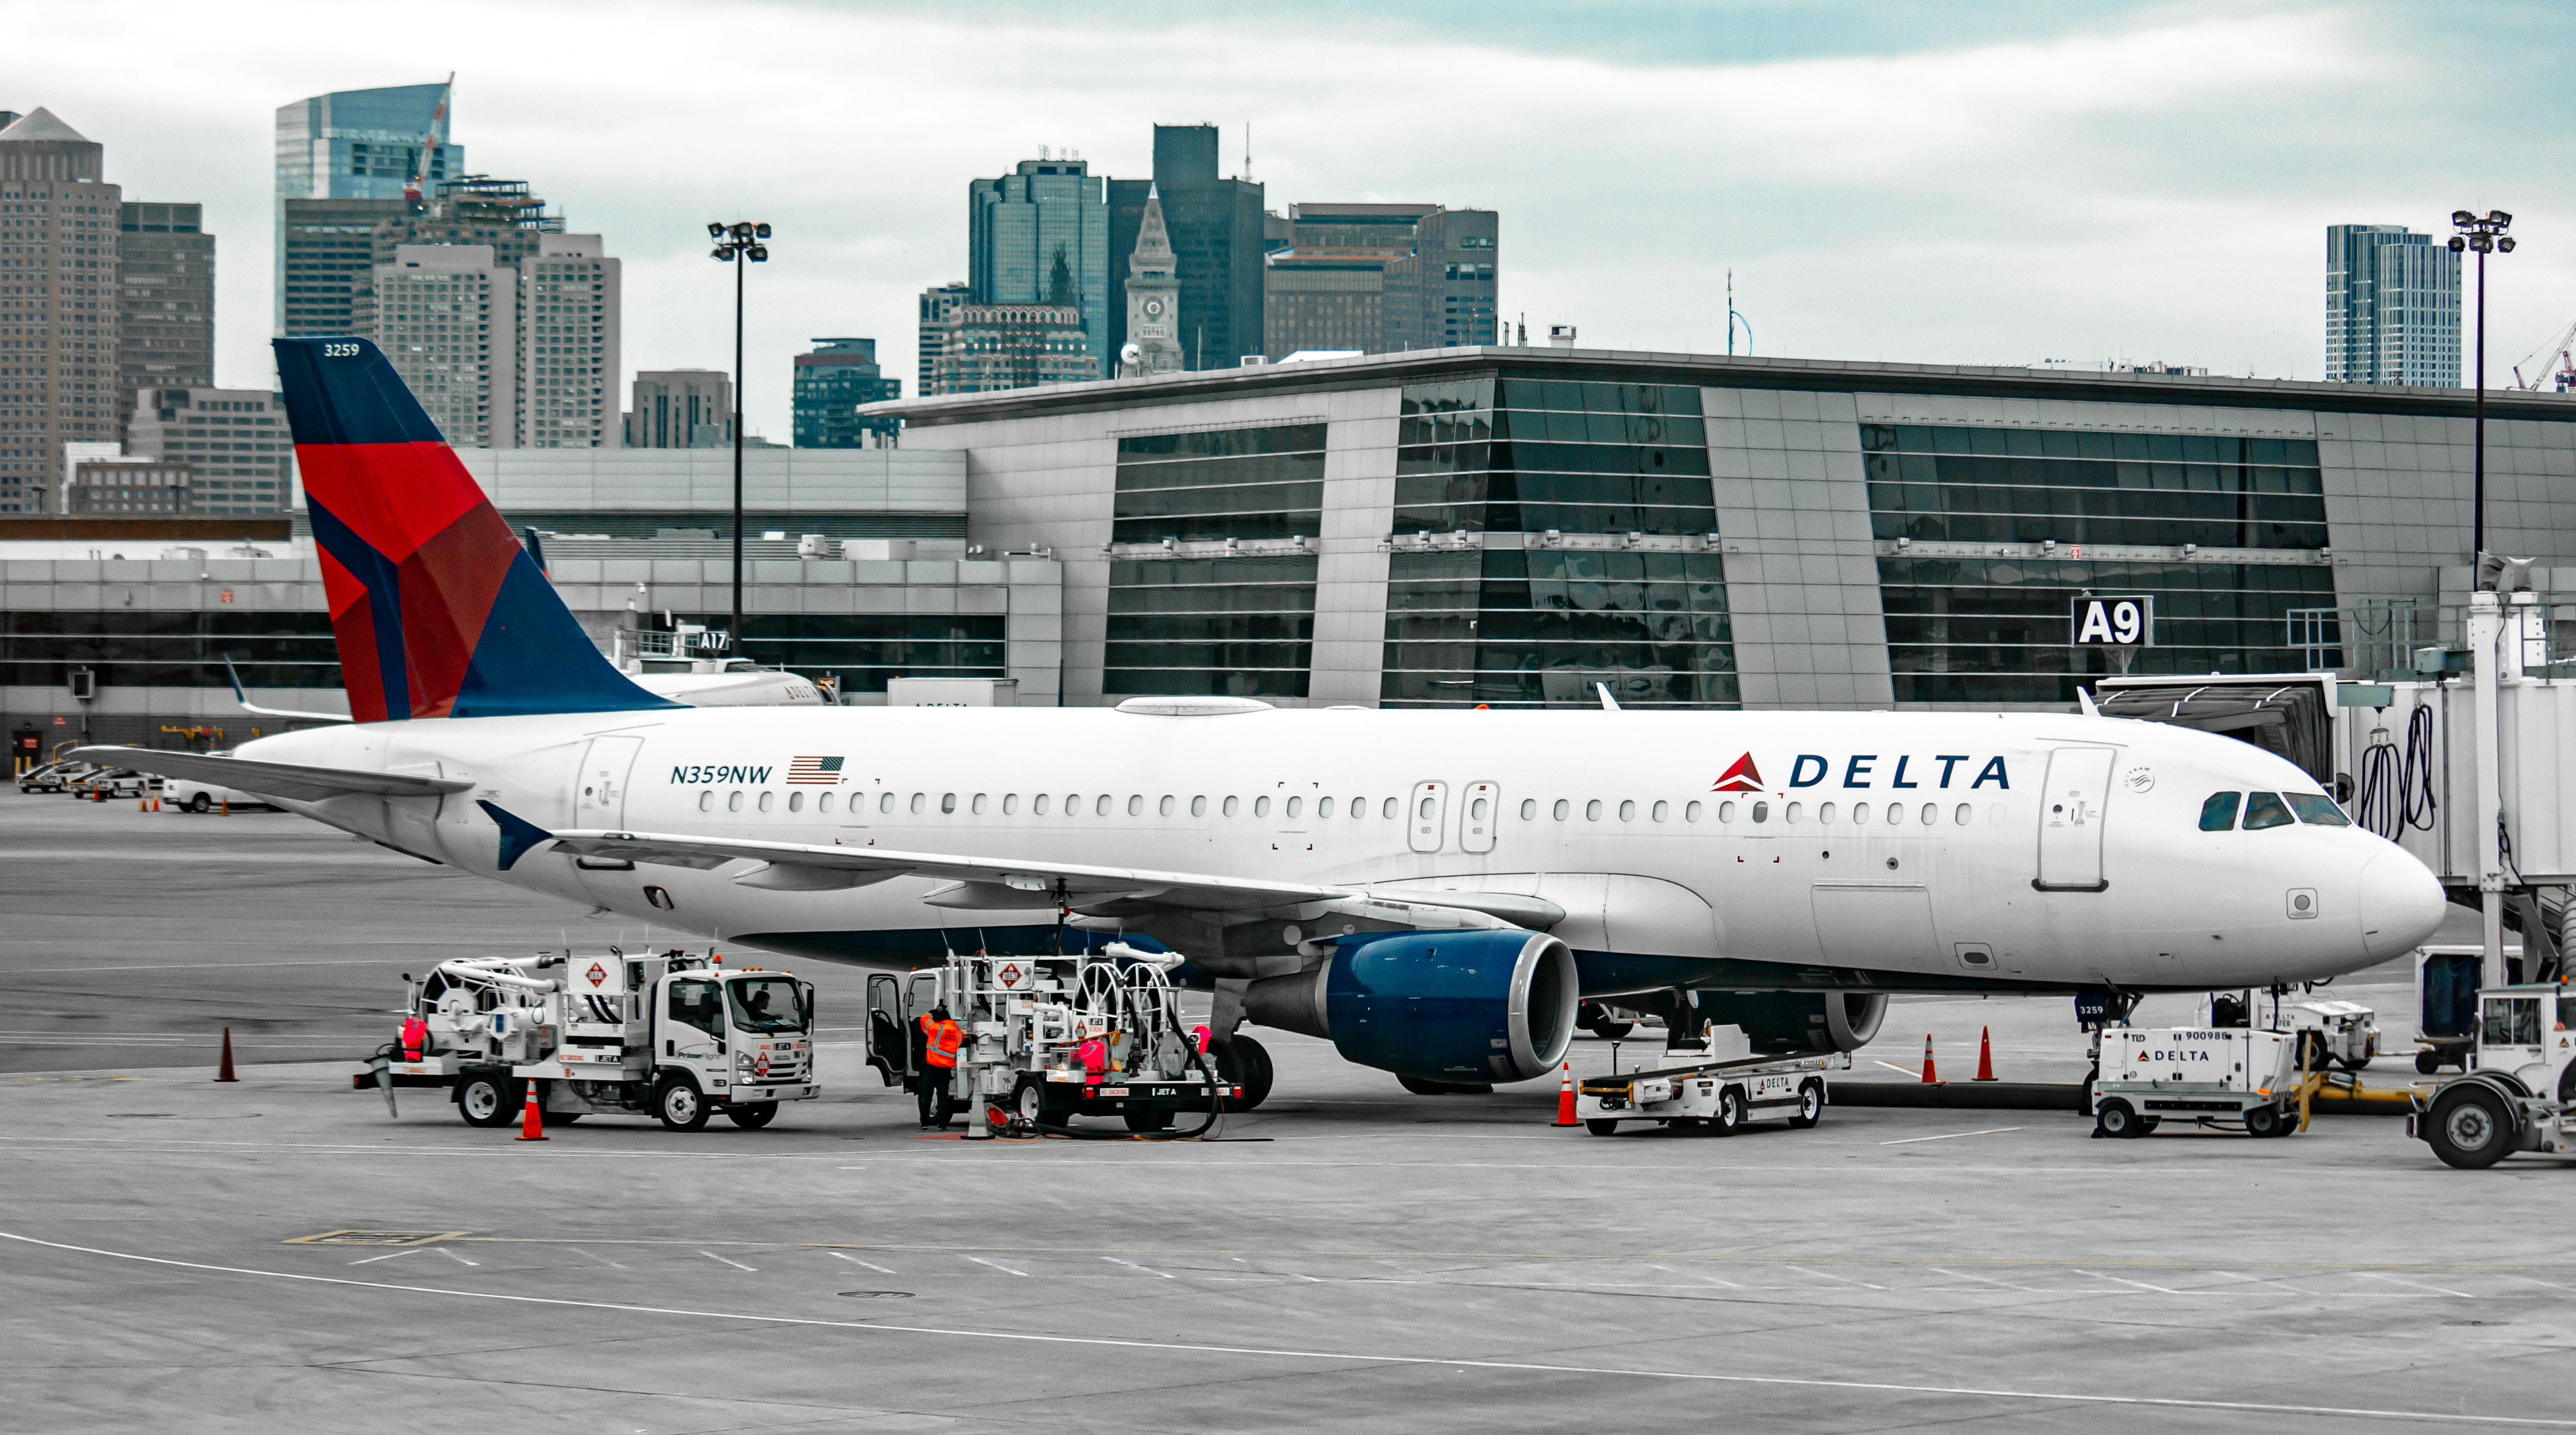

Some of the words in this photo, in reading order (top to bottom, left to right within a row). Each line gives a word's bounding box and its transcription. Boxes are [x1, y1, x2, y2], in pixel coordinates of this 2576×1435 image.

[324, 343, 359, 356] 3259
[2079, 601, 2139, 644] A9
[701, 633, 726, 649] A17
[790, 686, 819, 698] DELTA
[671, 766, 773, 784] N359NW
[1789, 754, 2010, 790] DELTA
[2124, 766, 2150, 788] SKYTEAM
[2080, 1006, 2103, 1014] 3259
[2155, 1050, 2209, 1062] DELTA
[1767, 1077, 1789, 1088] DELTA
